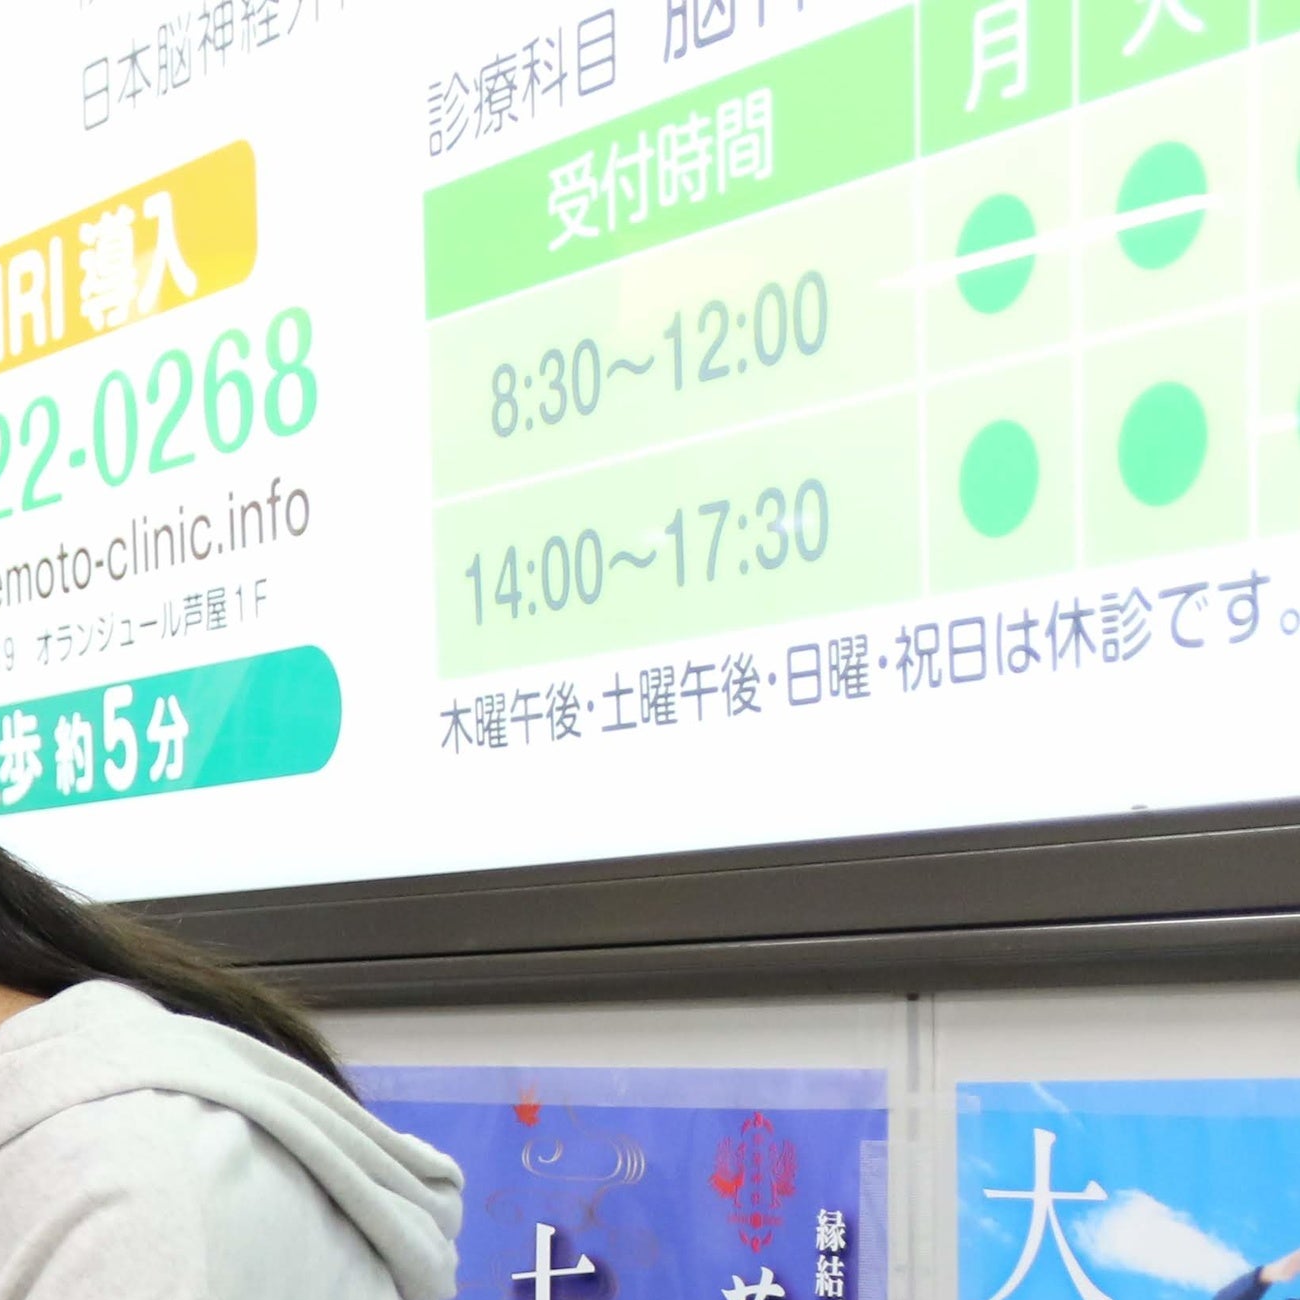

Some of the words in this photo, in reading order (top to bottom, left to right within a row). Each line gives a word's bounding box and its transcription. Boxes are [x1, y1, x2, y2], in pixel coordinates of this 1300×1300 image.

[82, 0, 344, 131] 日本脳神経
[427, 8, 616, 157] 診療科目
[963, 0, 1029, 113] 月
[547, 86, 775, 251] 受付時間
